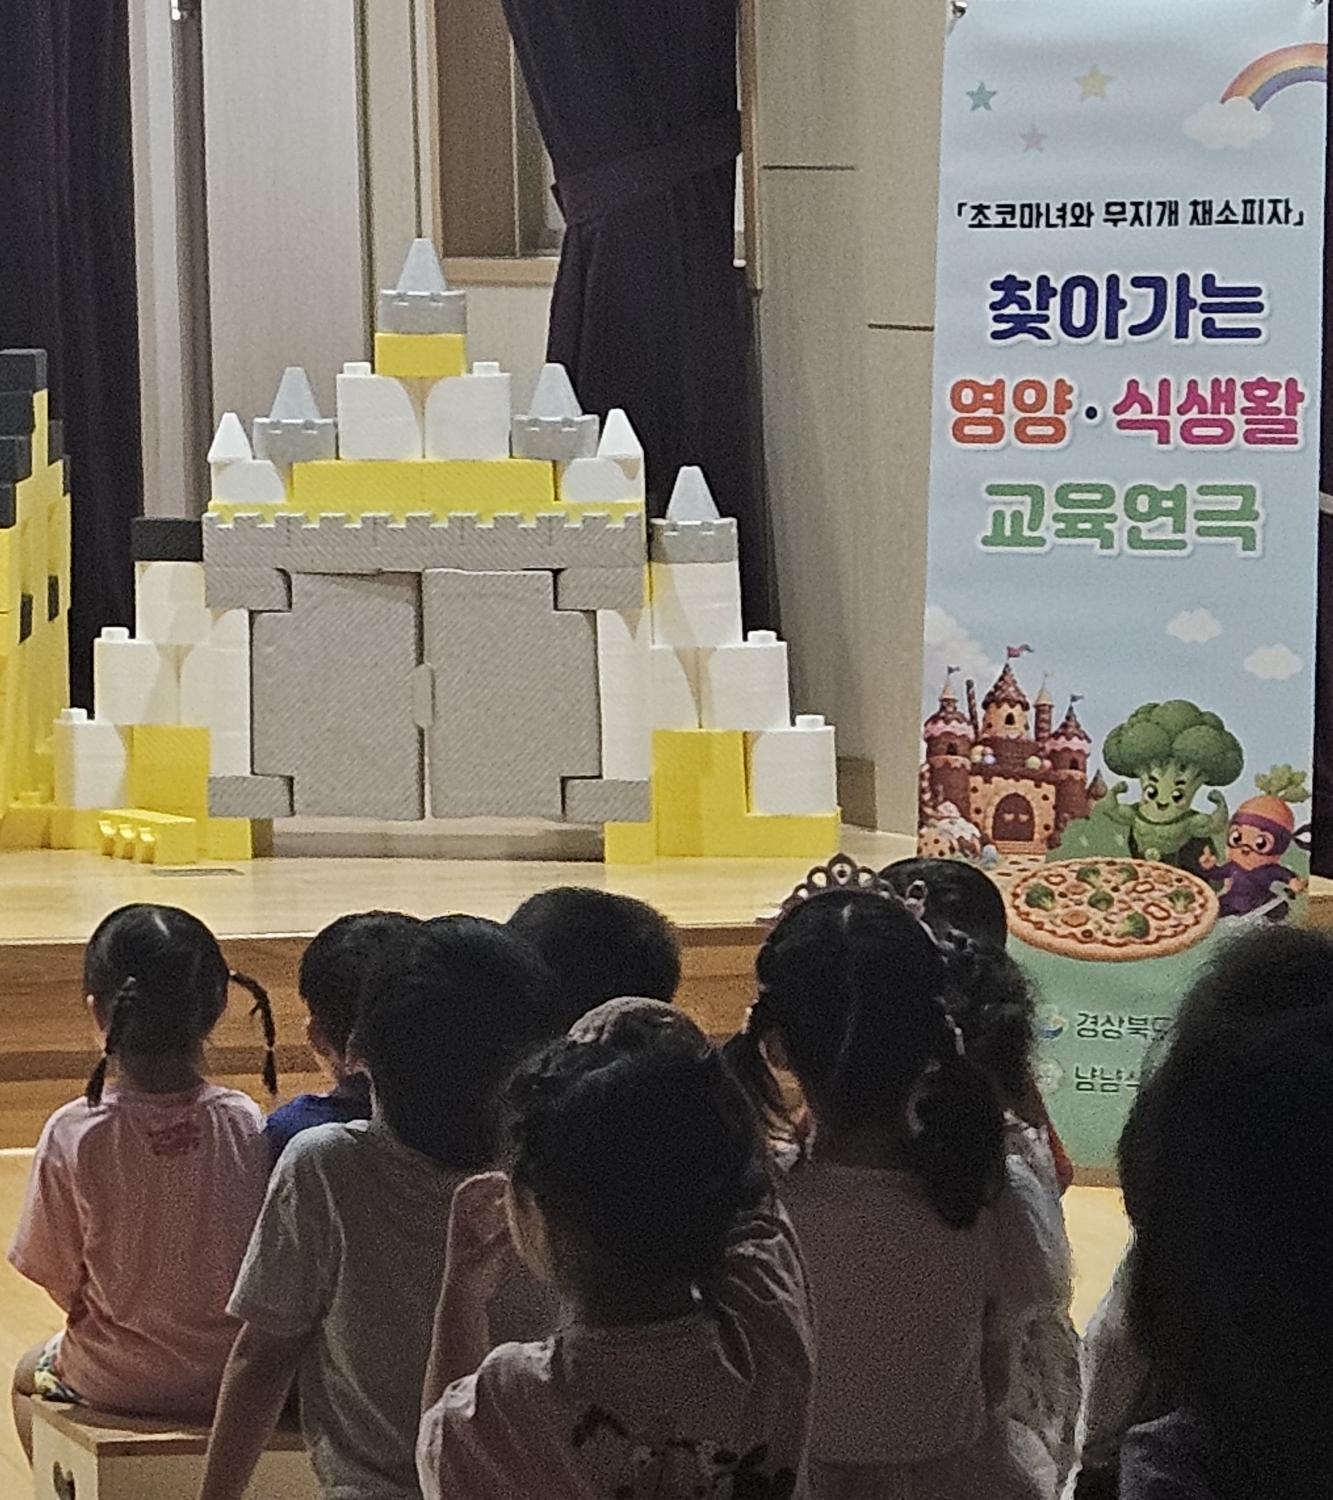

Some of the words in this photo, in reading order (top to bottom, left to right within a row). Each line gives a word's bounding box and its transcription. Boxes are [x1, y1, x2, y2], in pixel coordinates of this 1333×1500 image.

[1102, 199, 1179, 228] 무지개
[988, 272, 1265, 341] 찾아가는
[981, 482, 1261, 553] 교육연극
